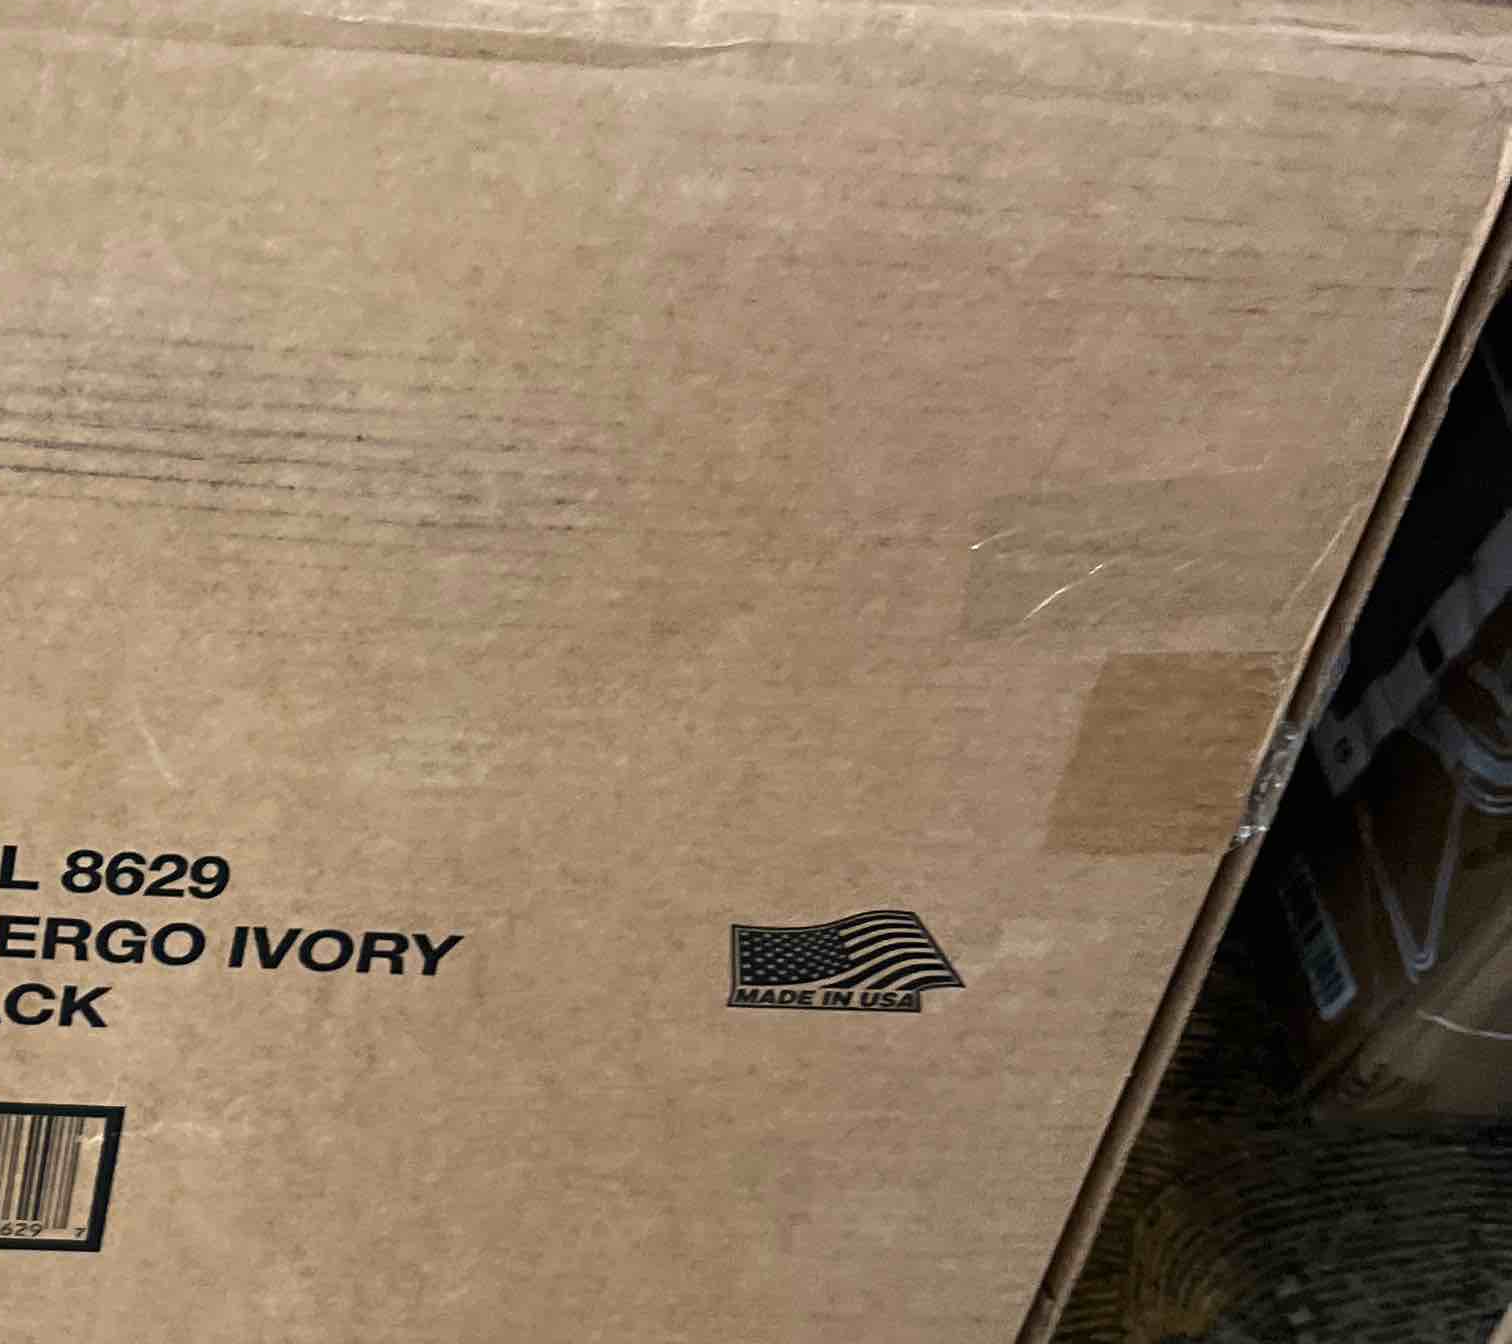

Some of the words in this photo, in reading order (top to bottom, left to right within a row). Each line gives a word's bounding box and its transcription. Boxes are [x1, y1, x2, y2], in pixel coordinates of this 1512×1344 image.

[61, 849, 230, 900] 8629
[228, 926, 465, 977] IVORY
[734, 988, 817, 1005] MADE
[822, 990, 854, 1006] IN
[859, 991, 915, 1007] USA
